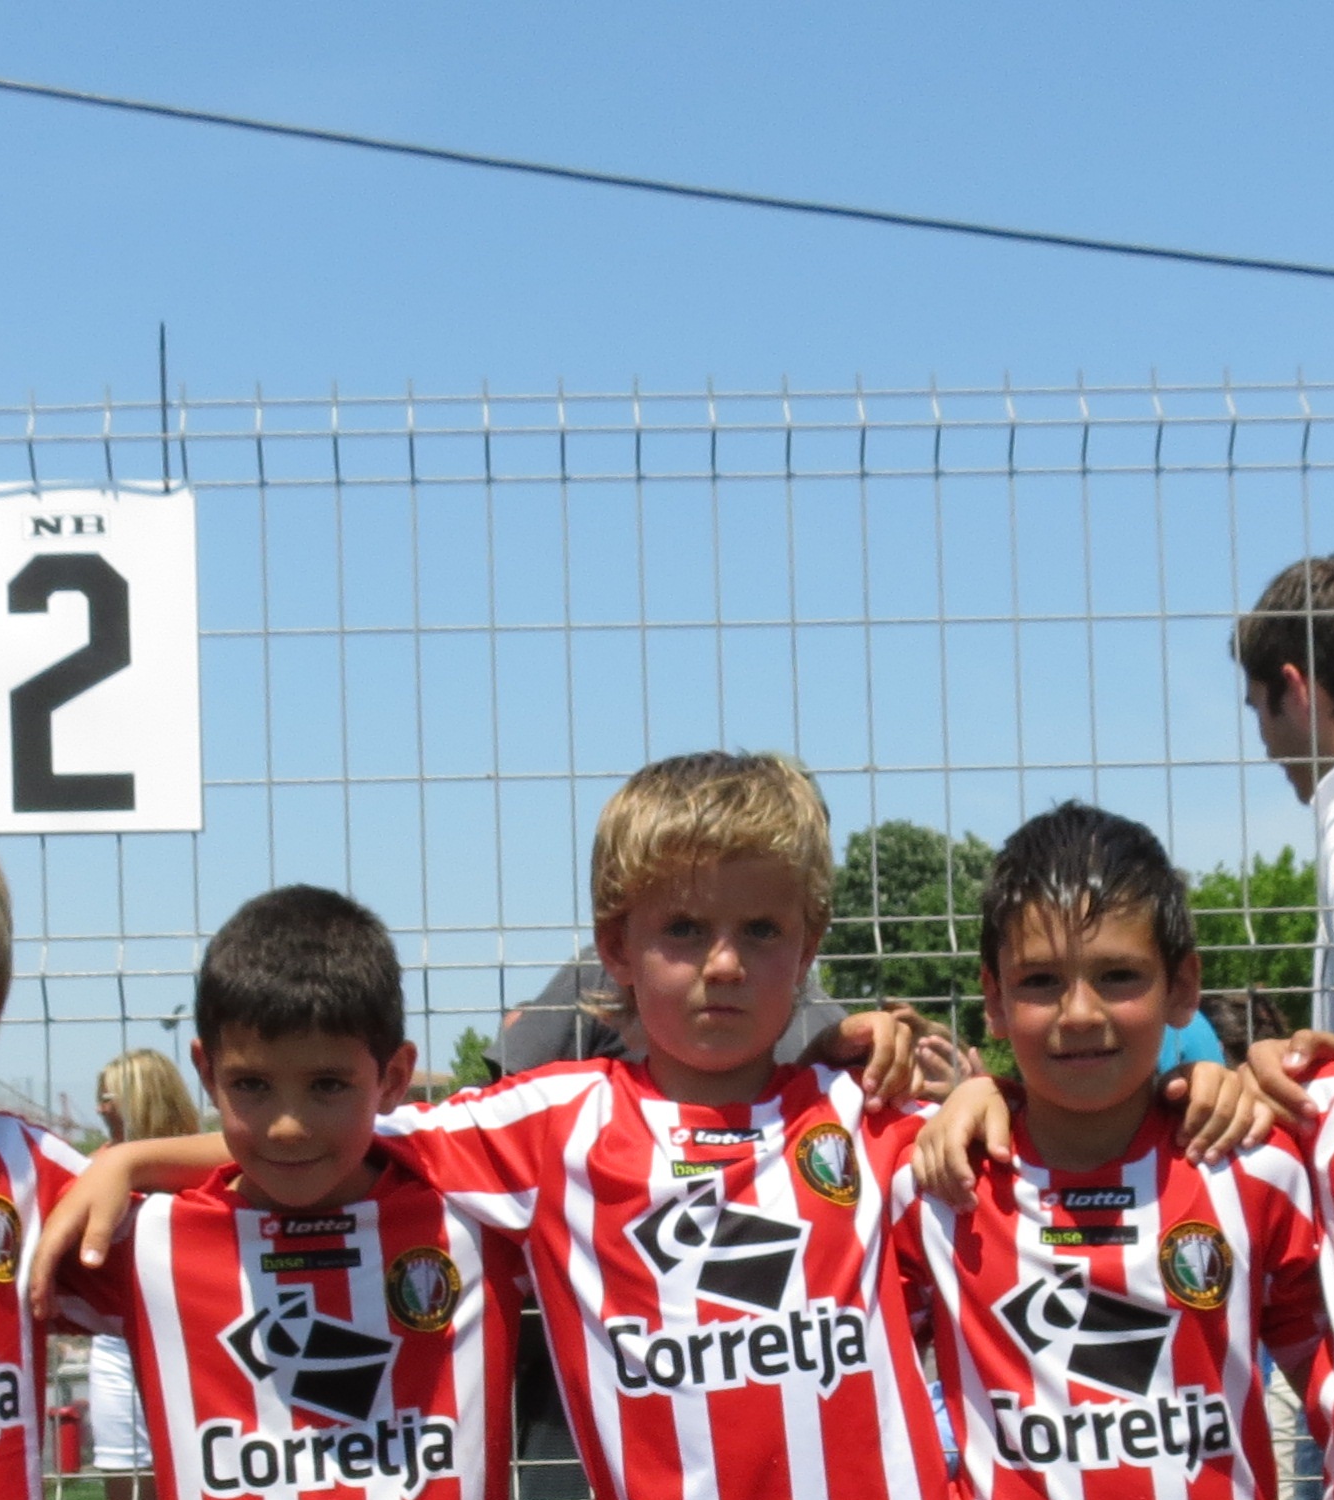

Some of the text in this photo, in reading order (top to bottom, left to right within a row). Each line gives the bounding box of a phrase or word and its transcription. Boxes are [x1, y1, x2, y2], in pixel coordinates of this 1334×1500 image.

[7, 552, 136, 813] 2
[285, 1218, 353, 1235] lotto
[1041, 1228, 1084, 1245] base
[1066, 1191, 1133, 1208] lotto
[607, 1305, 868, 1389] Corretja
[200, 1415, 454, 1492] Corretja
[989, 1392, 1232, 1473] Corretja
